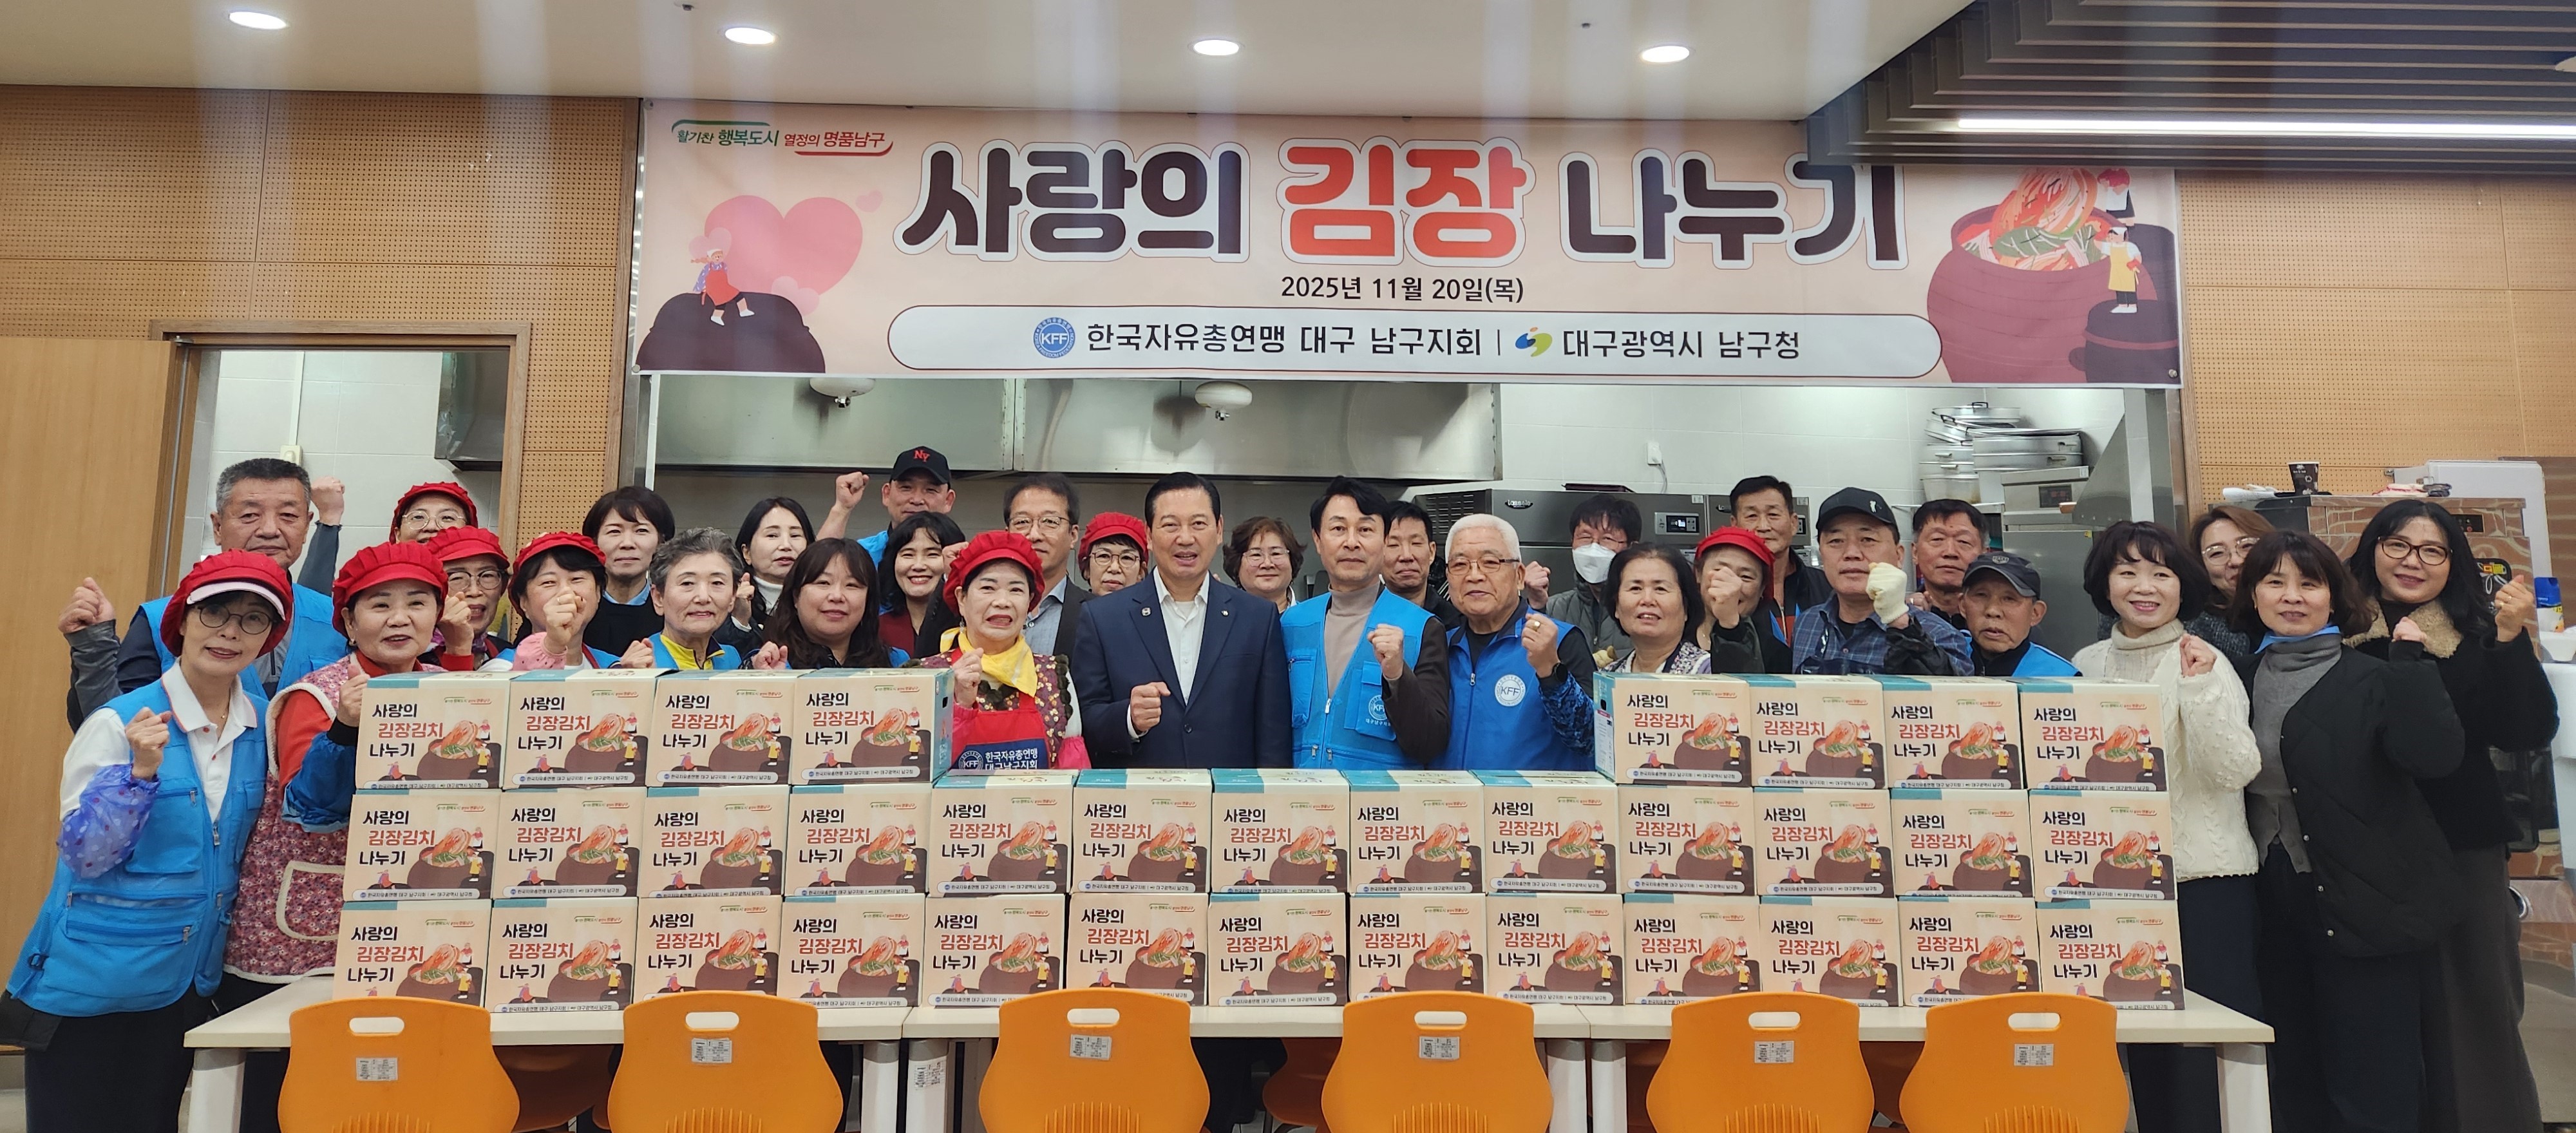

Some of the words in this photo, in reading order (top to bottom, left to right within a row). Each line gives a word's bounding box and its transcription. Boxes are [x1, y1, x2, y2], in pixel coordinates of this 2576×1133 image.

[677, 129, 714, 144] 활기찬
[718, 129, 779, 147] 행복도시
[784, 133, 820, 147] 열정의
[823, 131, 886, 148] 명품남구
[902, 148, 1242, 254] 사랑의
[1284, 144, 1528, 259] 김장
[1566, 156, 1900, 262] 나누기
[1282, 277, 1360, 299] 2025년
[1373, 278, 1421, 301] 11월
[1433, 278, 1522, 303] 20일(목)
[1041, 332, 1068, 345] KFF
[1088, 324, 1284, 352] 한국자유총연맹
[1302, 327, 1354, 353] 대구
[1372, 328, 1480, 355] 남구지회
[1564, 330, 1701, 357] 대구광역시
[1719, 332, 1798, 359] 남구청
[914, 450, 931, 462] NY
[1501, 686, 1520, 696] KFF
[520, 696, 565, 711] 사랑의
[665, 695, 710, 709] 사랑의
[806, 692, 849, 707] 사랑의
[1627, 694, 1668, 709] 사랑의
[372, 703, 417, 718] 사랑의
[1756, 702, 1798, 716] 사랑의
[1891, 705, 1933, 719] 사랑의
[2034, 707, 2076, 721] 사랑의
[526, 716, 591, 731] 김장김치
[672, 714, 735, 729] 김장김치
[813, 710, 875, 728] 김장김치
[1634, 713, 1694, 728] 김장김치
[379, 723, 444, 739] 김장김치
[1765, 721, 1824, 736] 김장김치
[1900, 724, 1961, 739] 김장김치
[2043, 726, 2104, 741] 김장김치
[518, 736, 562, 750] 나누기
[663, 734, 706, 748] 나누기
[805, 731, 848, 745] 나누기
[1628, 732, 1669, 747] 나누기
[370, 743, 415, 757] 나누기
[1759, 740, 1801, 754] 나누기
[1894, 743, 1937, 757] 나누기
[2037, 746, 2080, 759] 나누기
[985, 748, 1038, 763] 한국자유총연맹
[963, 760, 979, 769] KFF
[510, 807, 556, 823] 사랑의
[800, 808, 844, 824] 사랑의
[942, 804, 986, 819] 사랑의
[1084, 803, 1126, 819] 사랑의
[1224, 808, 1265, 823] 사랑의
[1357, 806, 1399, 821] 사랑의
[1492, 802, 1533, 817] 사랑의
[1628, 802, 1670, 817] 사랑의
[1763, 808, 1806, 822] 사랑의
[363, 810, 409, 825] 사랑의
[654, 812, 698, 827] 사랑의
[1902, 815, 1945, 830] 사랑의
[2042, 811, 2085, 826] 사랑의
[517, 827, 582, 843] 김장김치
[808, 828, 870, 844] 김장김치
[949, 824, 1012, 839] 김장김치
[1091, 823, 1151, 839] 김장김치
[1231, 828, 1291, 843] 김장김치
[1365, 826, 1425, 841] 김장김치
[1500, 821, 1559, 836] 김장김치
[1636, 821, 1696, 837] 김장김치
[1772, 826, 1833, 842] 김장김치
[368, 830, 435, 846] 김장김치
[661, 830, 724, 848] 김장김치
[1911, 834, 1972, 849] 김장김치
[2050, 830, 2112, 846] 김장김치
[508, 848, 553, 862] 나누기
[799, 848, 843, 863] 나누기
[942, 843, 985, 858] 나누기
[1083, 843, 1125, 858] 나누기
[1224, 848, 1265, 862] 나누기
[1358, 846, 1400, 861] 나누기
[1493, 841, 1534, 855] 나누기
[1629, 841, 1671, 856] 나누기
[1766, 846, 1809, 861] 나누기
[359, 850, 406, 866] 나누기
[653, 852, 697, 867] 나누기
[1905, 853, 1947, 868] 나누기
[2045, 850, 2088, 864] 나누기
[649, 913, 694, 929] 사랑의
[934, 914, 978, 929] 사랑의
[1081, 908, 1124, 924] 사랑의
[1357, 913, 1399, 928] 사랑의
[1497, 912, 1539, 928] 사랑의
[502, 923, 547, 938] 사랑의
[793, 919, 837, 933] 사랑의
[1219, 917, 1262, 933] 사랑의
[1633, 919, 1676, 933] 사랑의
[1771, 920, 1814, 935] 사랑의
[1909, 917, 1951, 932] 사랑의
[2049, 924, 2093, 939] 사랑의
[350, 926, 398, 942] 사랑의
[656, 932, 719, 949] 김장김치
[1087, 928, 1150, 944] 김장김치
[1365, 933, 1426, 949] 김장김치
[1505, 931, 1565, 948] 김장김치
[799, 938, 862, 955] 김장김치
[940, 934, 1003, 950] 김장김치
[1227, 936, 1289, 953] 김장김치
[1642, 938, 1703, 955] 김장김치
[1779, 938, 1840, 956] 김장김치
[1917, 936, 1978, 953] 김장김치
[357, 946, 426, 962] 김장김치
[508, 942, 574, 959] 김장김치
[1080, 949, 1122, 964] 나누기
[2059, 944, 2121, 960] 김장김치
[648, 954, 692, 969] 나누기
[791, 959, 835, 974] 나누기
[933, 955, 976, 970] 나누기
[1220, 957, 1263, 973] 나누기
[1358, 953, 1401, 968] 나누기
[1499, 953, 1540, 967] 나누기
[1635, 958, 1678, 973] 나누기
[1772, 960, 1815, 975] 나누기
[1911, 957, 1954, 971] 나누기
[348, 967, 394, 982] 나누기
[500, 964, 545, 979] 나누기
[2053, 964, 2098, 978] 나누기
